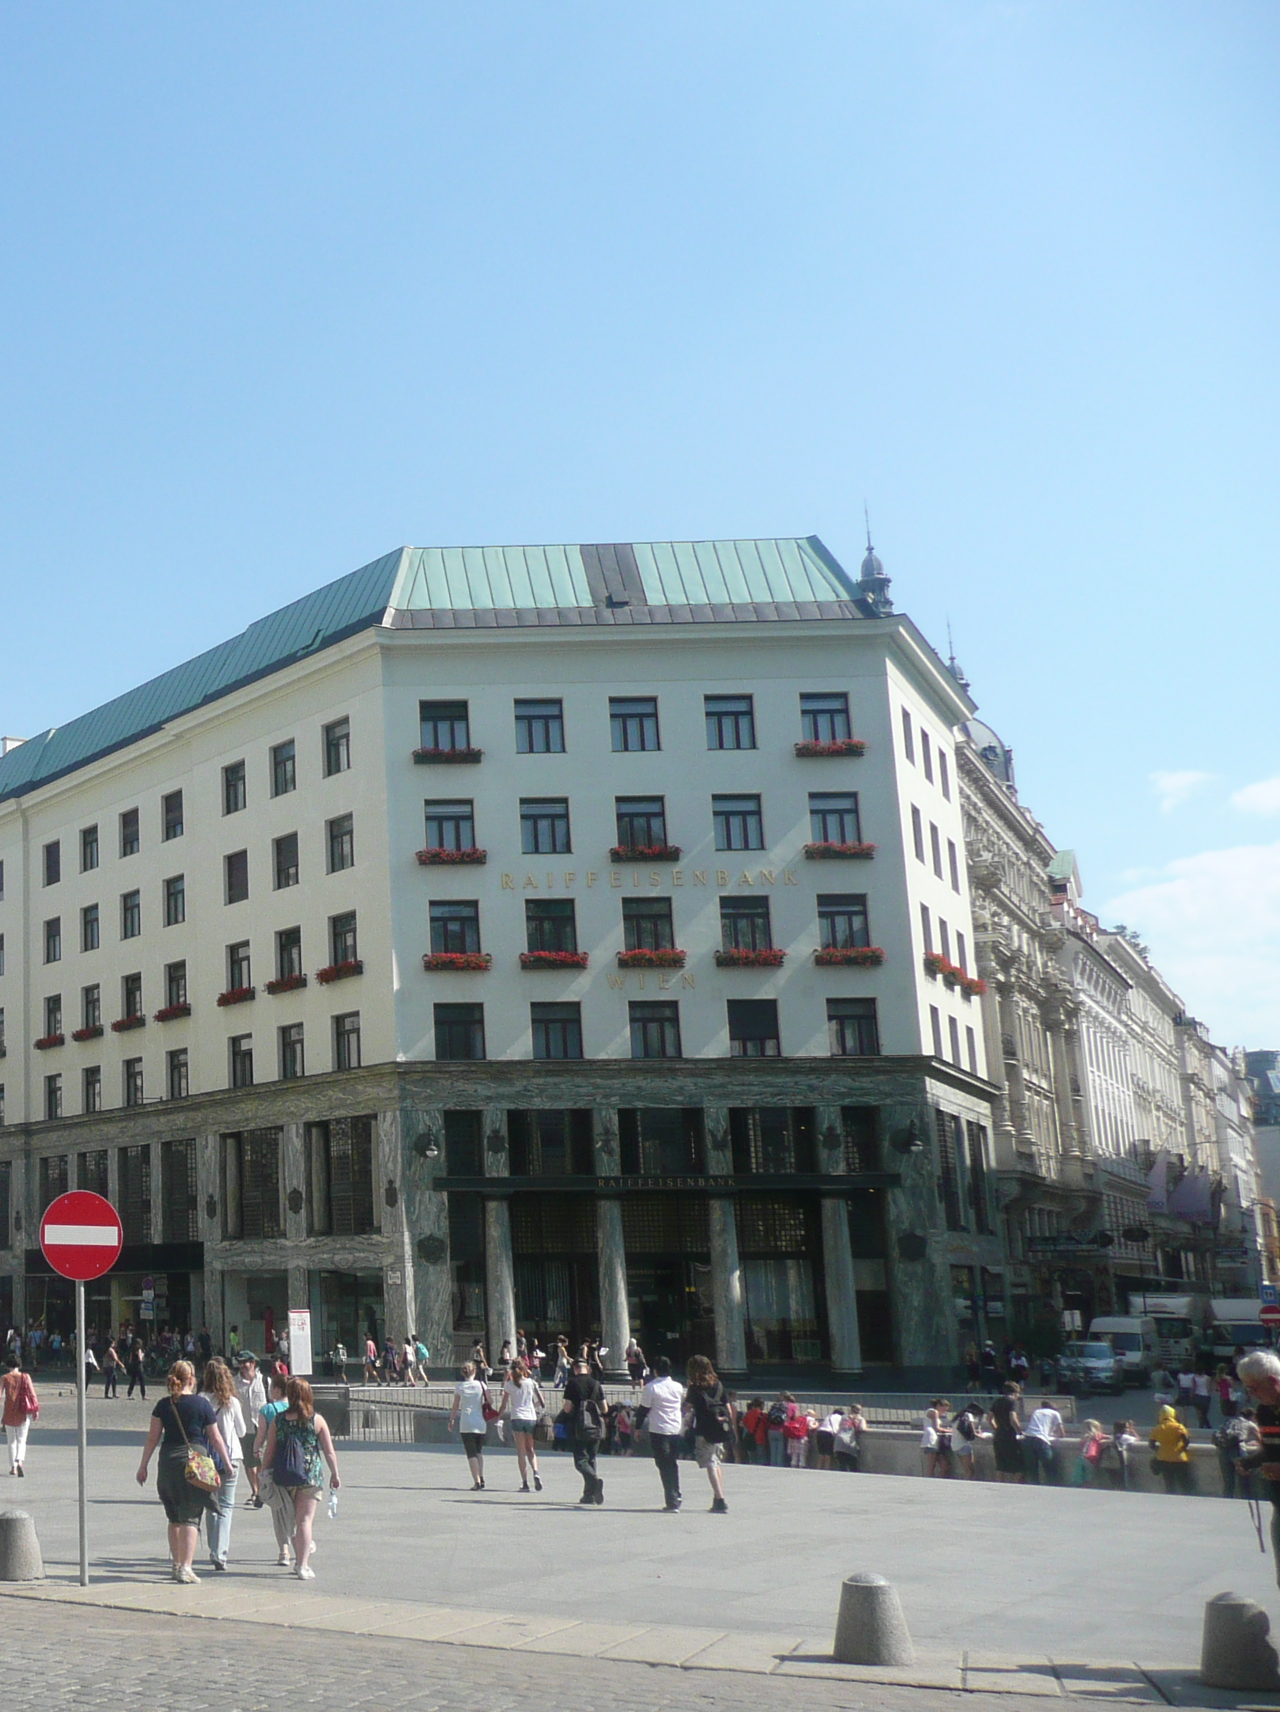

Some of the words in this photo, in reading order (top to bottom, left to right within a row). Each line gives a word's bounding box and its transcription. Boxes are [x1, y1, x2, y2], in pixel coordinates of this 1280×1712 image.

[501, 869, 798, 890] RAIFFEISENBANK
[606, 972, 697, 990] WIEN
[598, 1177, 736, 1188] RAIFFEISENBANK
